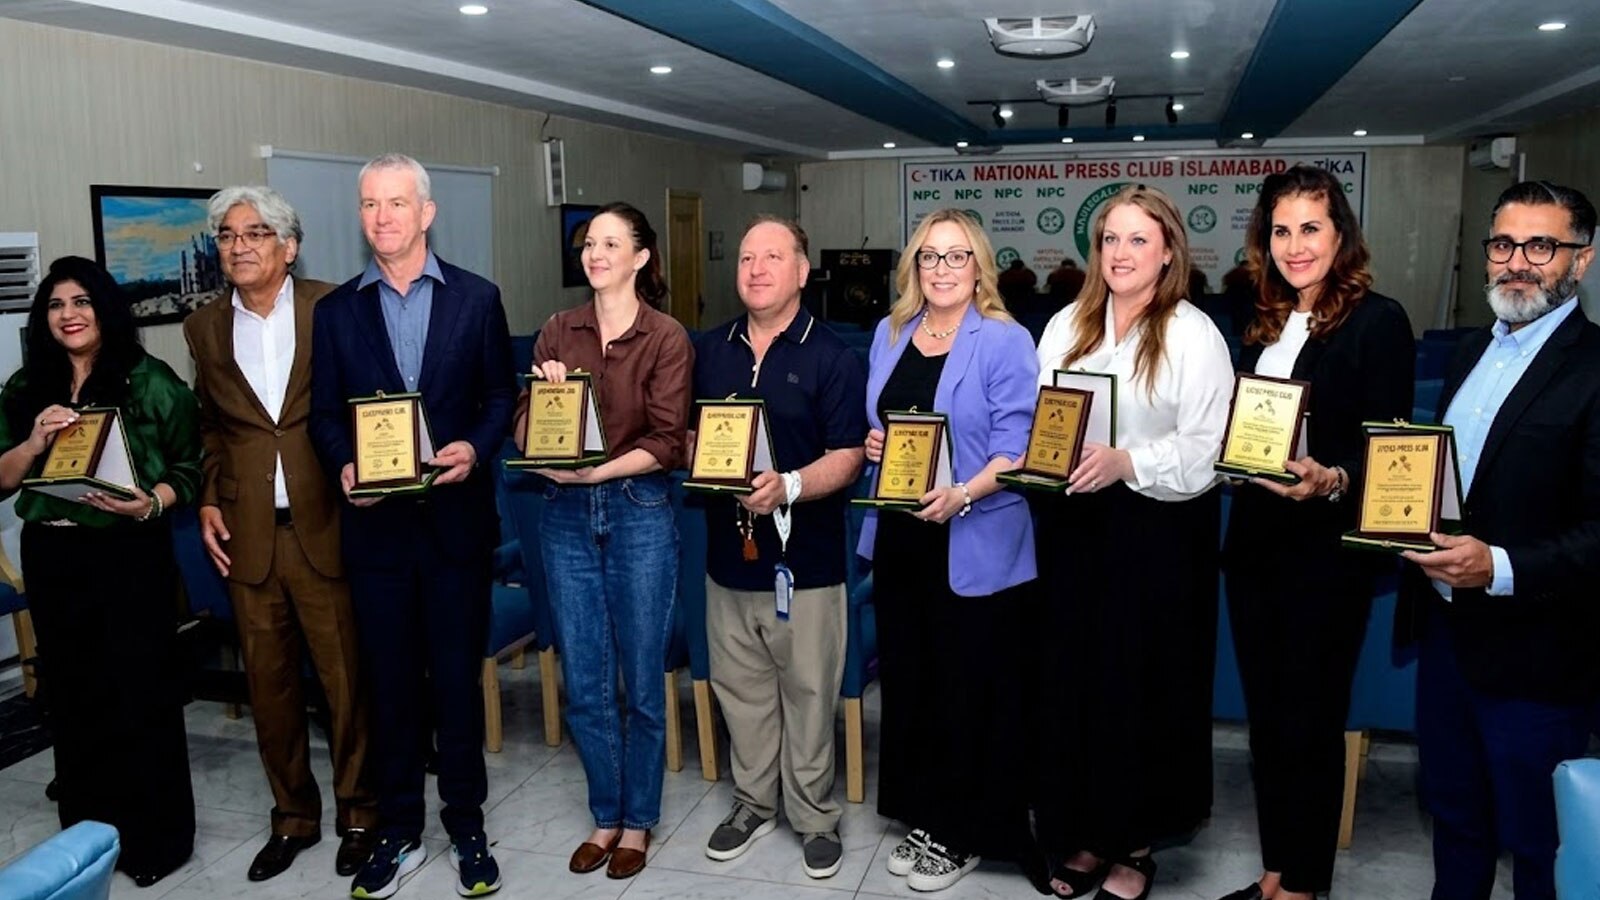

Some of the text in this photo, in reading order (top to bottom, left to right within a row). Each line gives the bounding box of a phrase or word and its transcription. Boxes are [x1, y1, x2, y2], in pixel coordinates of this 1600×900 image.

[929, 168, 966, 182] TIKA
[973, 164, 1059, 182] NATIONAL
[1065, 162, 1120, 179] PRESS
[1126, 161, 1174, 177] CLUB
[1180, 159, 1287, 176] ISLAMABAD
[913, 186, 1065, 200] NPC NPC NPC NPC
[1188, 183, 1218, 195] NPC
